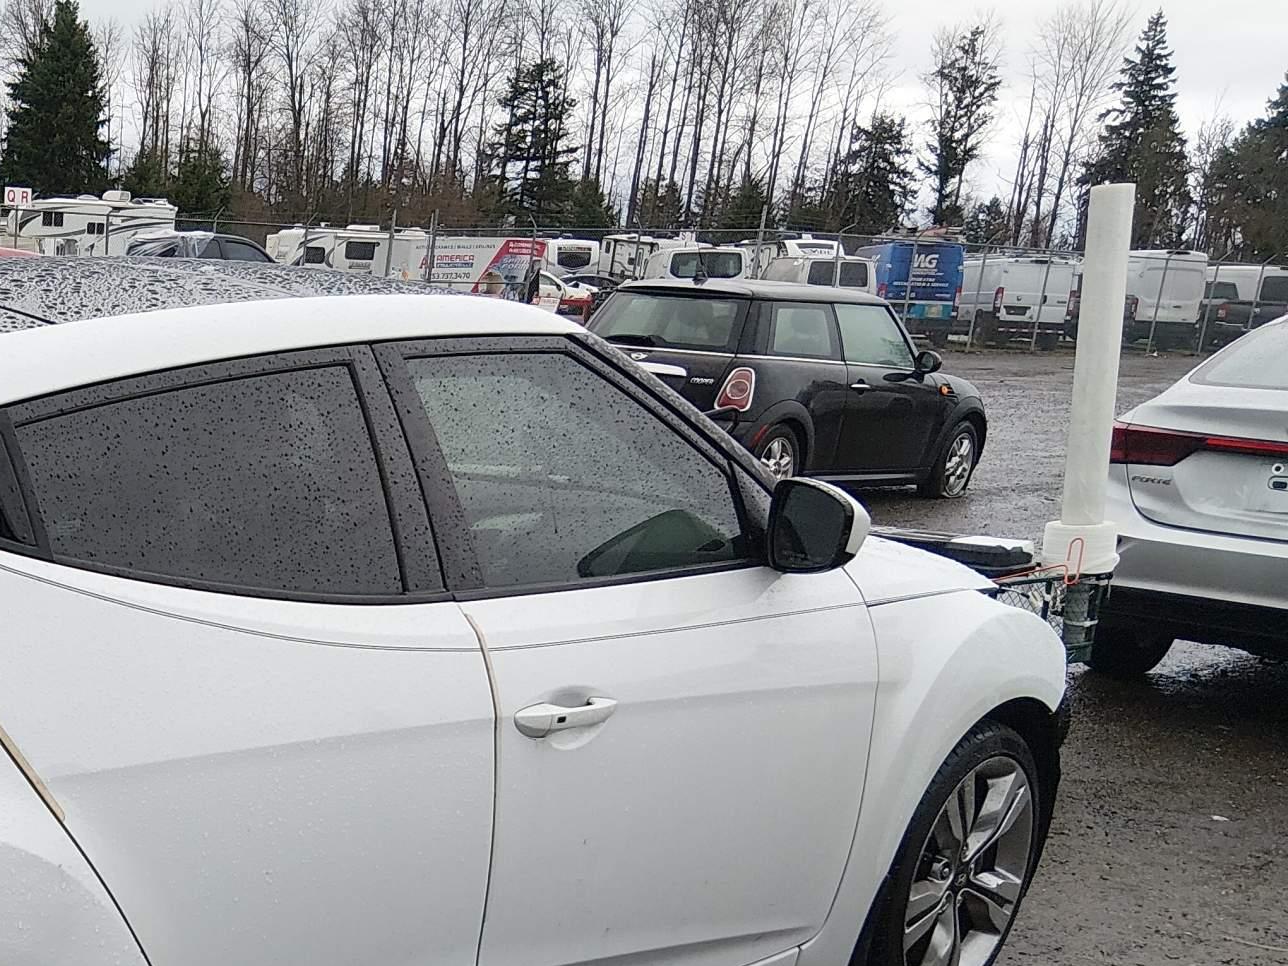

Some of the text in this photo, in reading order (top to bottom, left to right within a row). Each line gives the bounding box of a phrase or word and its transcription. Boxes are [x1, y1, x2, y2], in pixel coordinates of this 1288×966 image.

[7, 189, 29, 203] Q R
[436, 254, 475, 262] AMERICA
[690, 376, 714, 385] COOPER
[1131, 475, 1173, 486] FORTE
